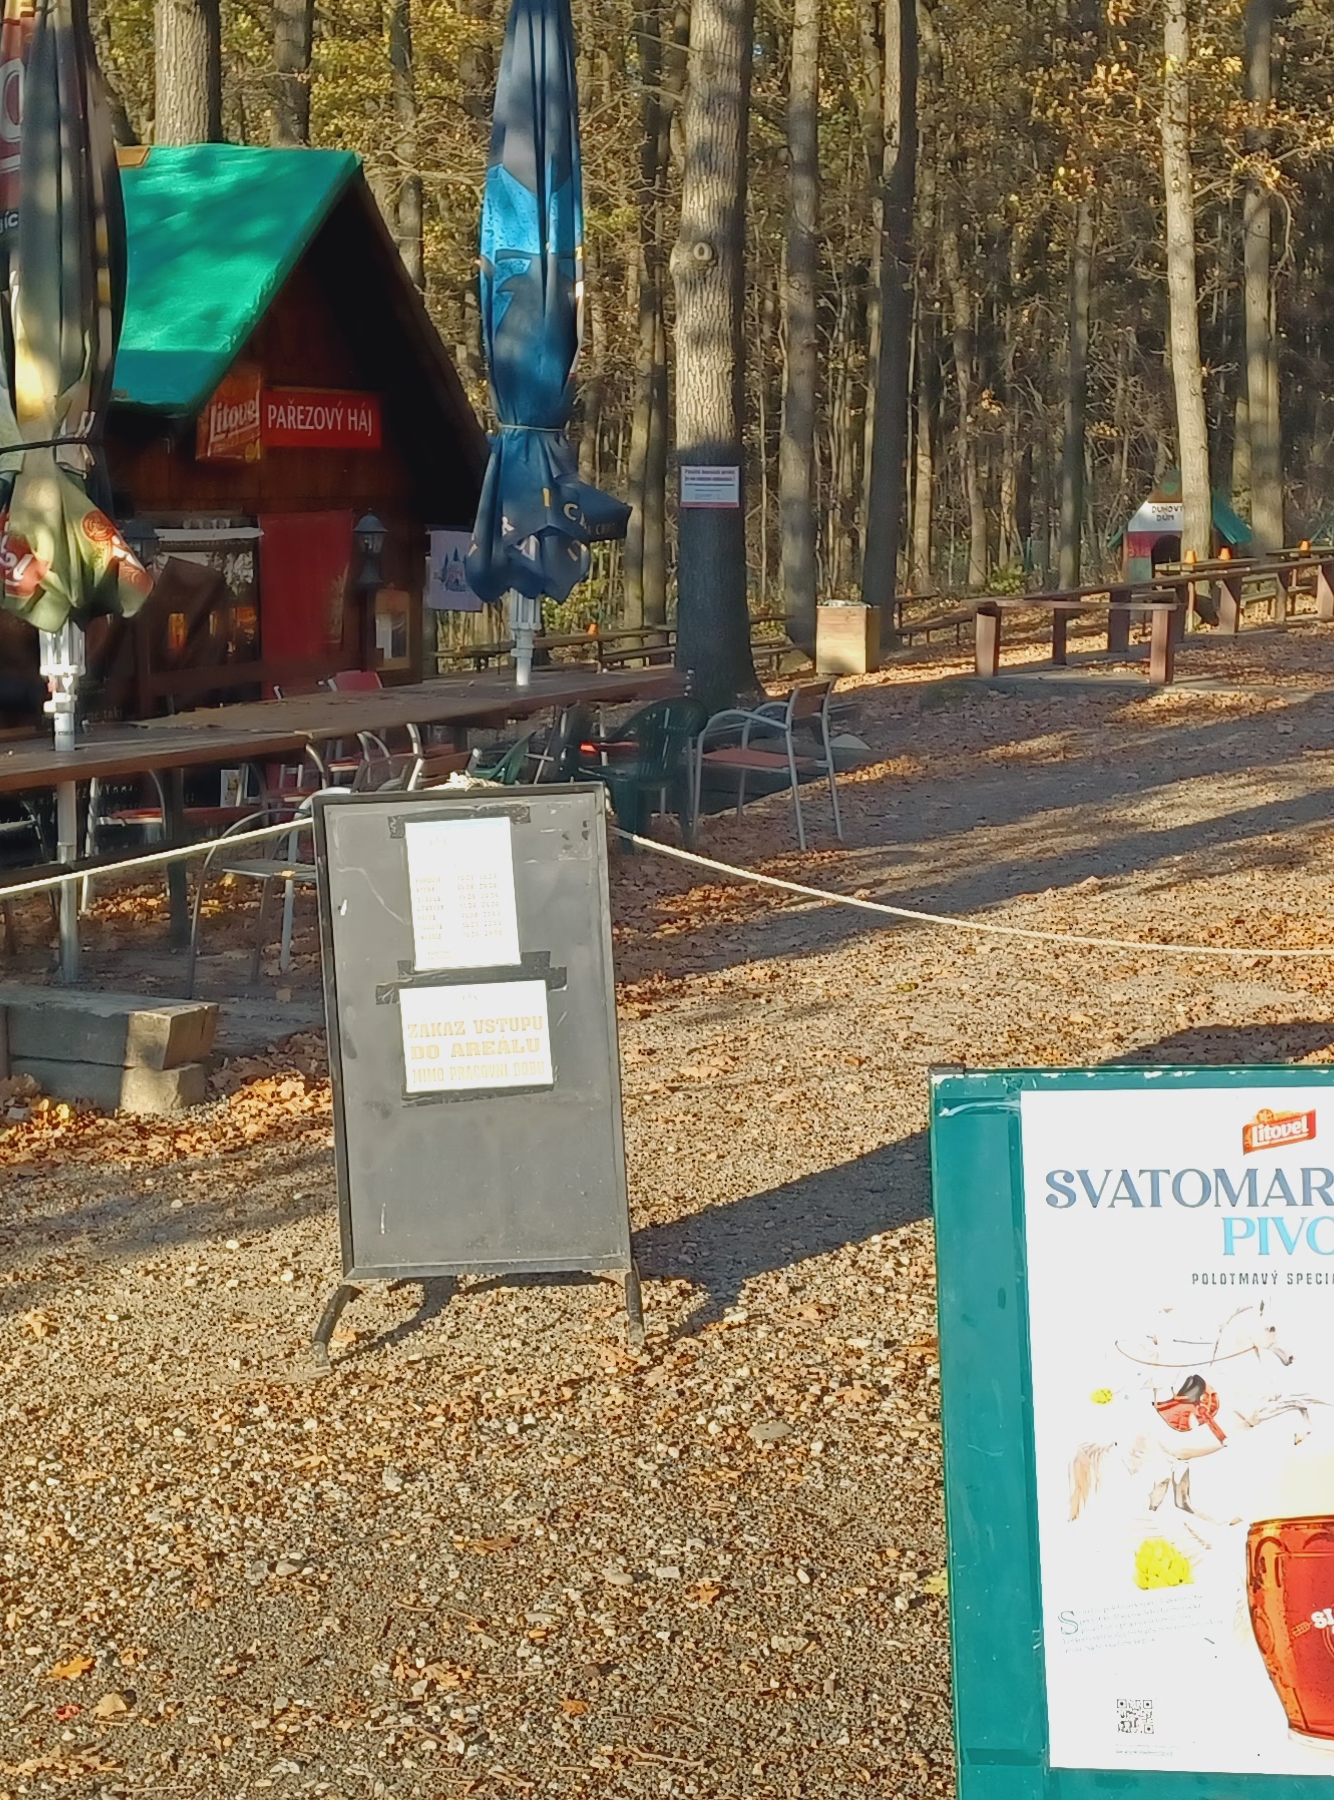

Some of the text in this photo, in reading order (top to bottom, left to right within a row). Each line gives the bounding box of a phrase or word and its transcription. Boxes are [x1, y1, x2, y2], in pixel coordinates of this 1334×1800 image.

[210, 389, 260, 443] Litovel
[268, 398, 372, 437] PAŘEZOVÝ HÁJ
[408, 1015, 543, 1038] ZÁKAZ VSTUPU
[410, 1036, 540, 1060] DO AREÁLU
[1251, 1115, 1309, 1147] Litovel
[1192, 1270, 1278, 1285] POLOTMAVÝ
